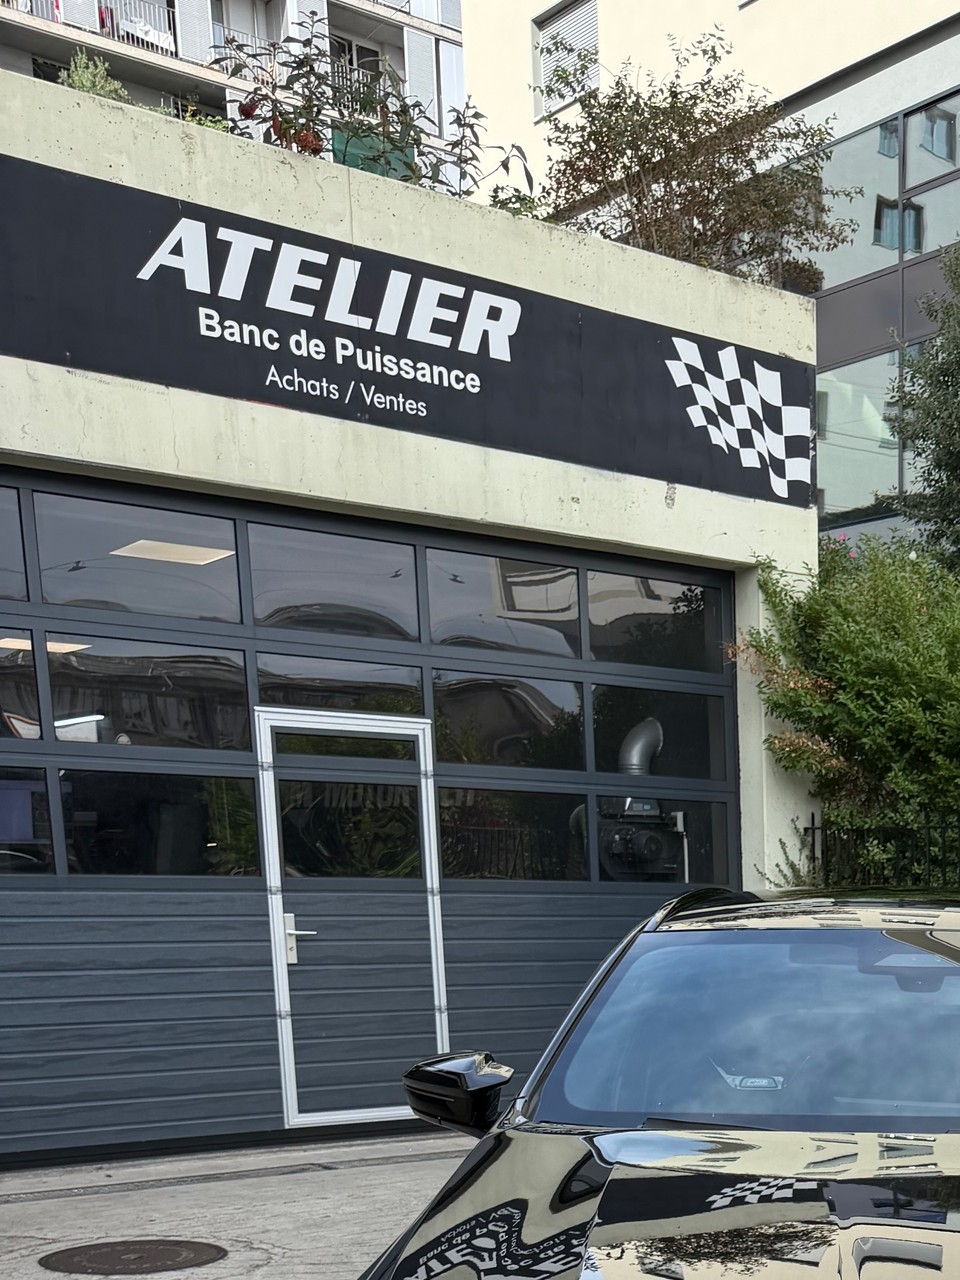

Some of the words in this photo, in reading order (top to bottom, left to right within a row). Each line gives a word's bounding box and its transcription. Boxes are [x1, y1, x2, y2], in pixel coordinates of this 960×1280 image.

[136, 217, 522, 362] ATELIER
[198, 307, 281, 351] Banc
[289, 329, 326, 360] de
[335, 337, 482, 394] Puissance
[265, 364, 339, 400] Achats
[359, 383, 428, 417] Ventes
